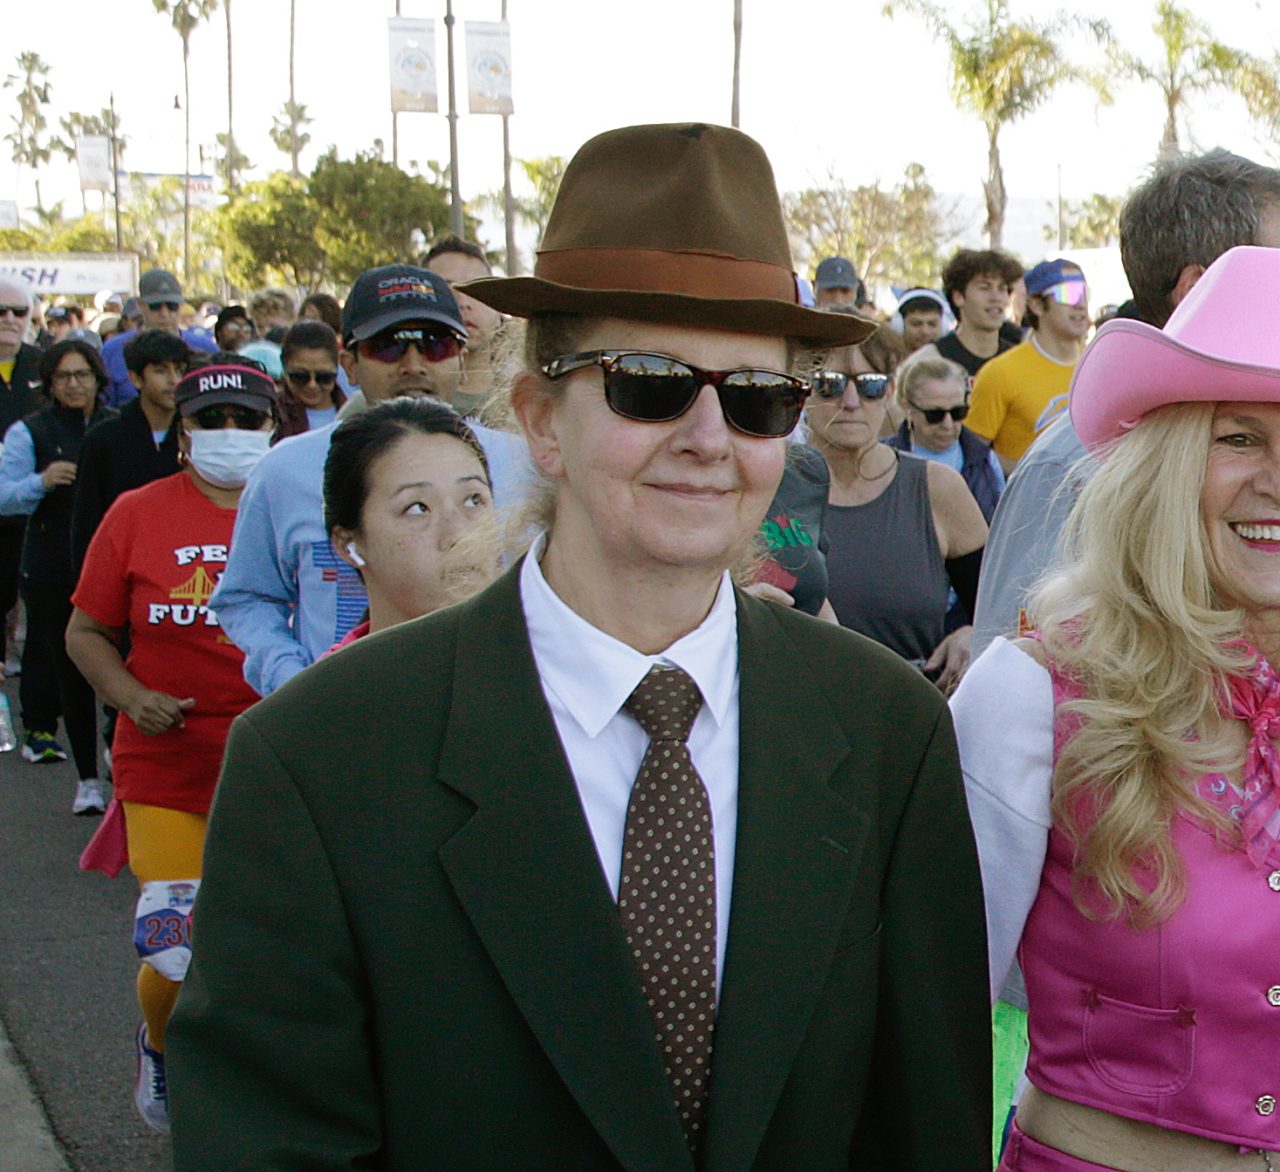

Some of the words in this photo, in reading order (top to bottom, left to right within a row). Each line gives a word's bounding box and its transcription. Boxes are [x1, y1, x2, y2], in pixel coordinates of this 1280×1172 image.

[377, 276, 433, 289] ORACLE
[198, 375, 243, 393] RUN!
[174, 544, 228, 566] FE
[148, 603, 220, 627] FUT
